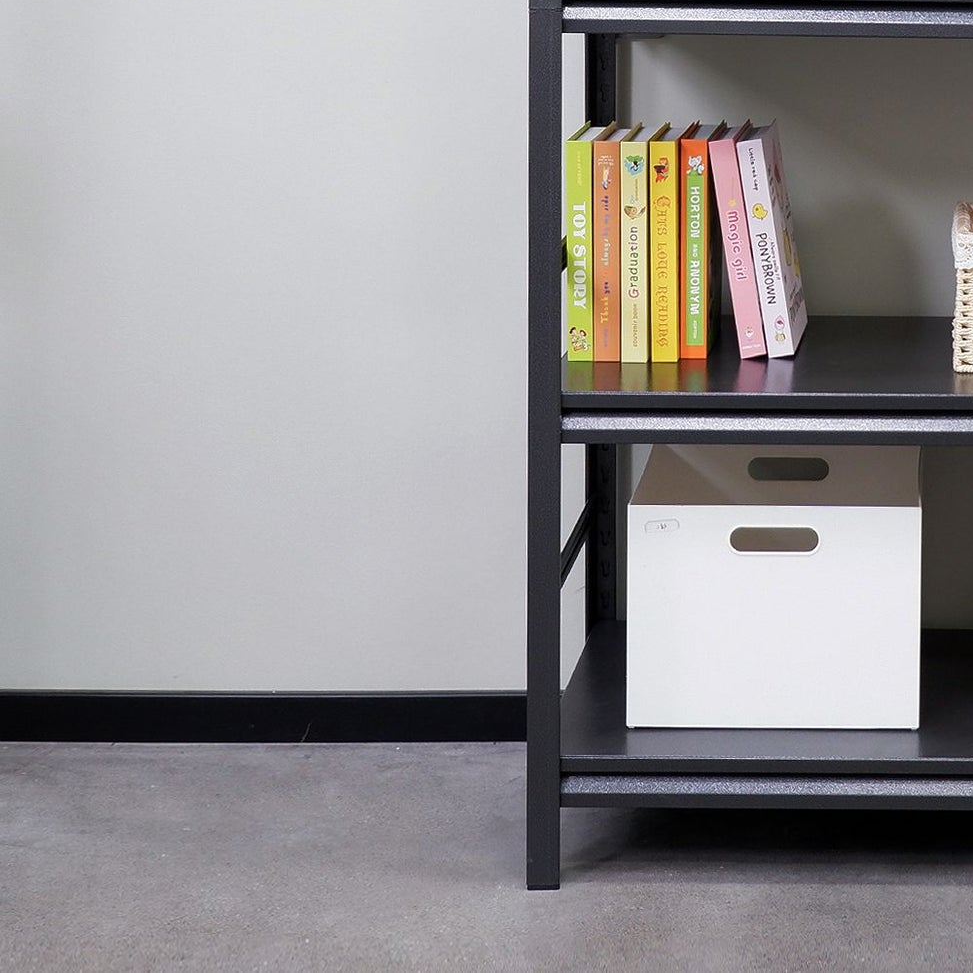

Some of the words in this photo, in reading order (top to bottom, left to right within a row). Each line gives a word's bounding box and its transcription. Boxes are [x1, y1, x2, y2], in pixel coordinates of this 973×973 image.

[572, 201, 588, 240] TOY
[690, 186, 701, 239] HORTON
[571, 244, 587, 310] STORY
[628, 226, 640, 299] Graduation
[689, 260, 701, 315] ANONYM
[731, 259, 748, 281] girl
[755, 232, 777, 305] PONYBROWN
